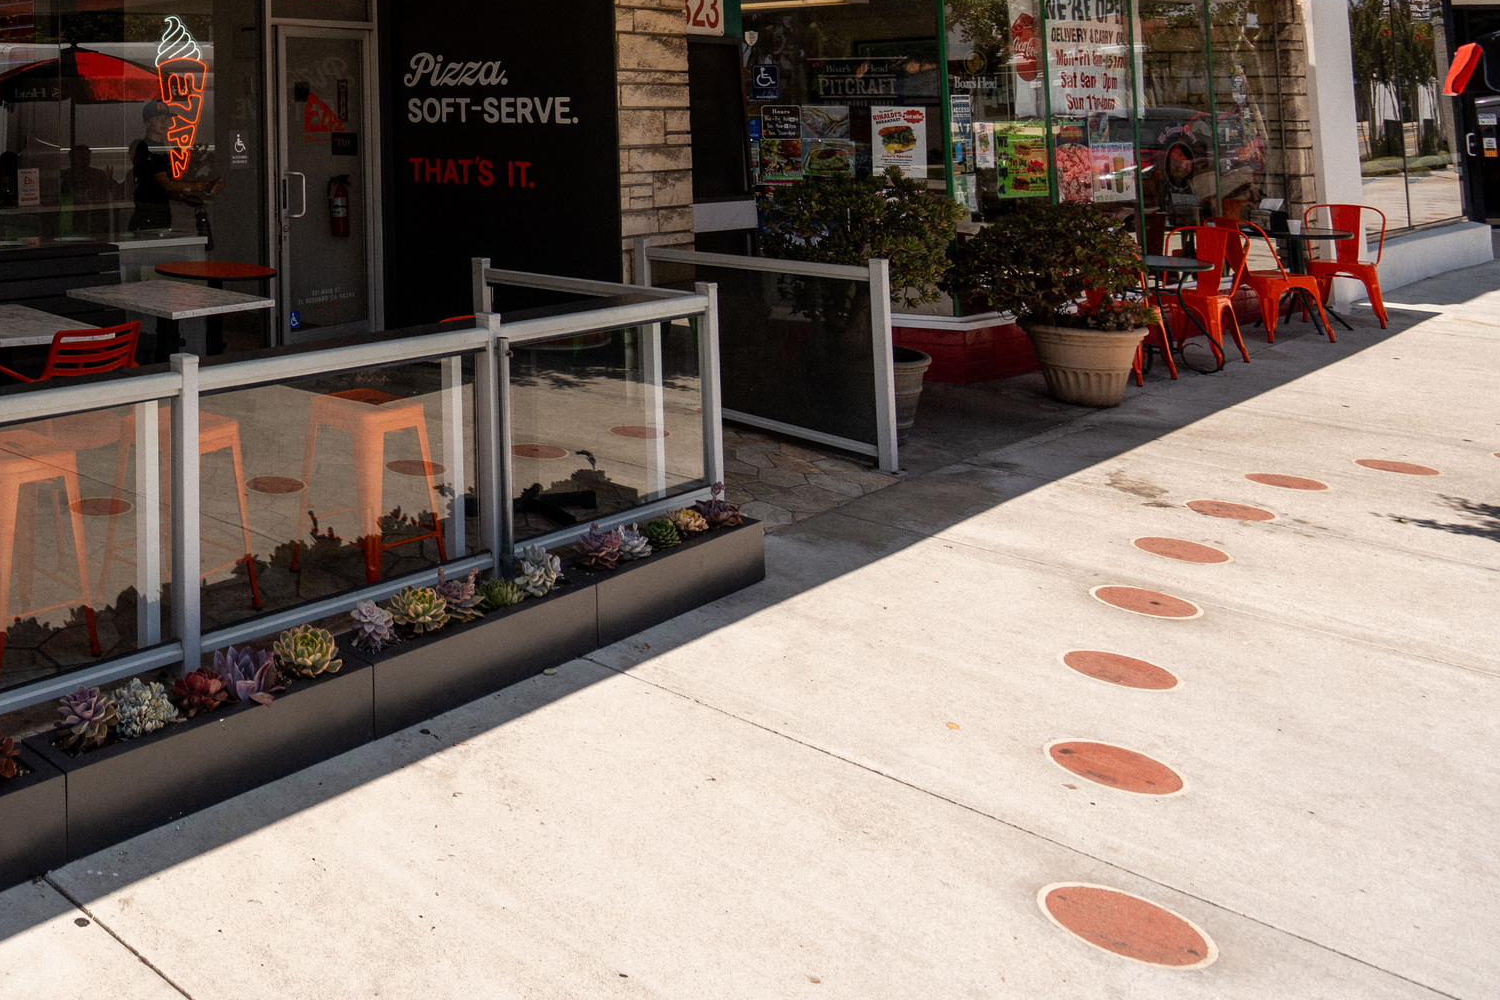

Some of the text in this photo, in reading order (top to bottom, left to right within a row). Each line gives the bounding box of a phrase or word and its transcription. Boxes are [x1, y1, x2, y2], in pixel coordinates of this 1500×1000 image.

[1051, 27, 1087, 43] DELIVERY
[977, 76, 997, 89] Head
[1061, 71, 1077, 88] Sat
[408, 96, 579, 124] SOFT-SERVE.
[1066, 93, 1084, 110] Sun
[873, 112, 902, 121] RINALDI'S
[409, 155, 535, 188] THAT'S IT.
